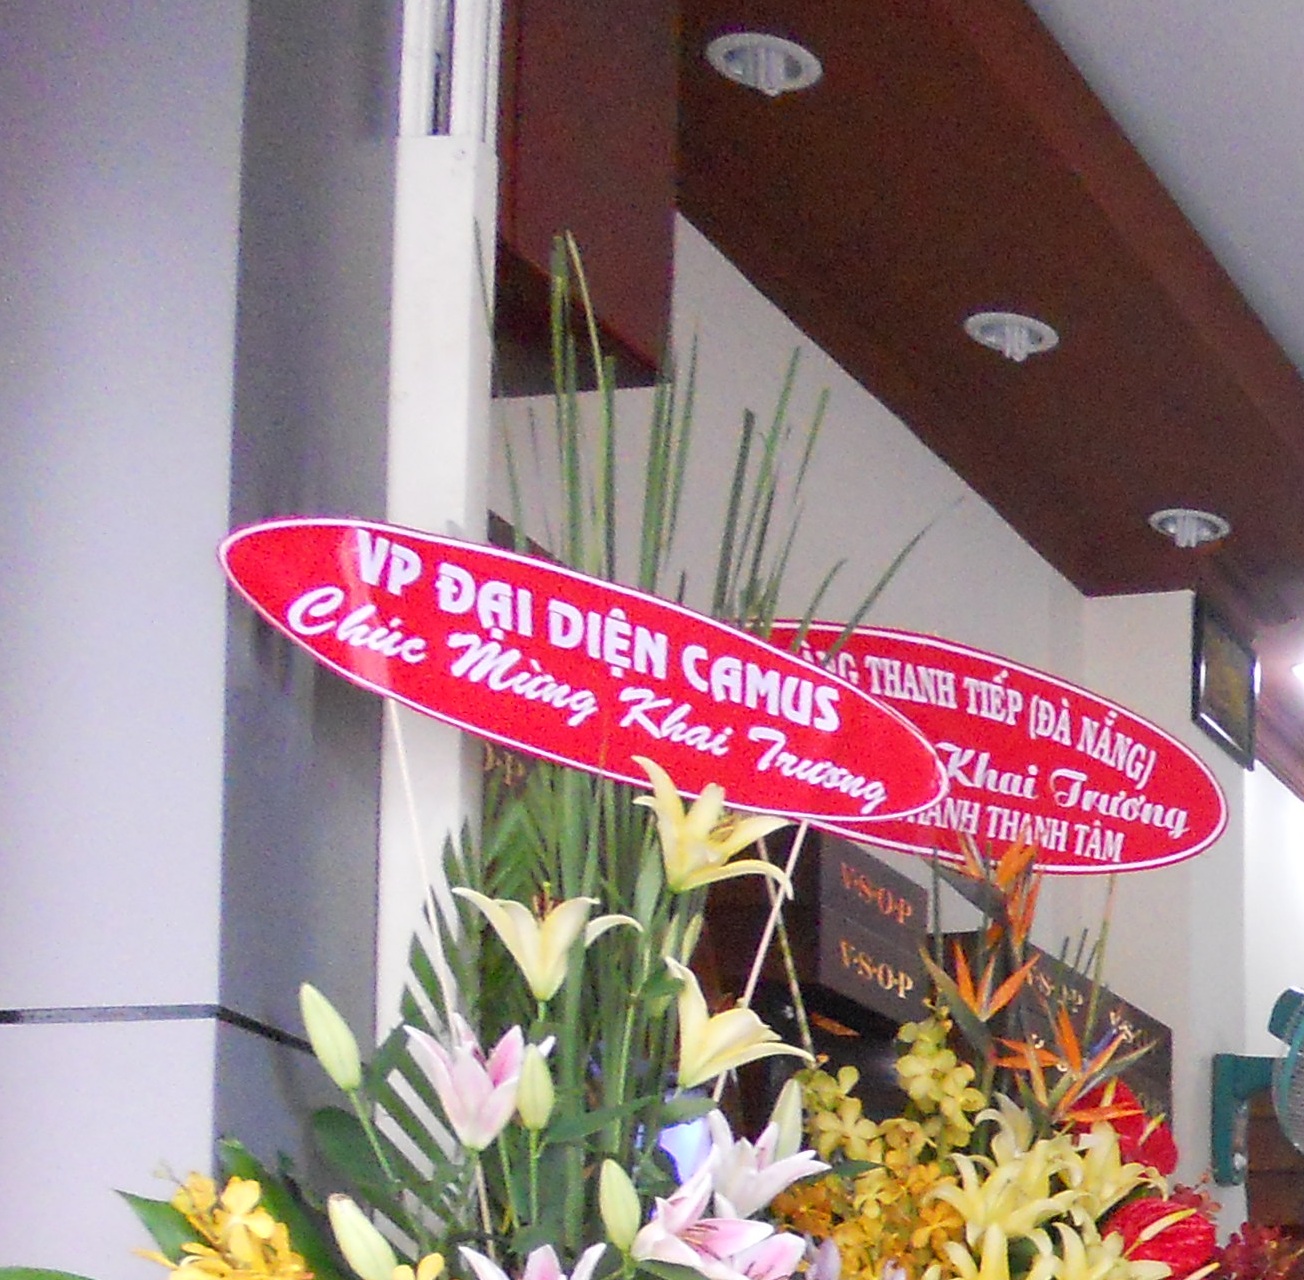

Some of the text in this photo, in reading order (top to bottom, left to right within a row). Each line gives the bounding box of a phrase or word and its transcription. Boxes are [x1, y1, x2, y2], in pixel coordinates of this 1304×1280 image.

[356, 529, 840, 732] VP ĐẠI DIỆN CAMUS
[287, 586, 887, 814] Chúc Mừng Khai Trương
[864, 655, 958, 709] THANH
[963, 670, 1024, 726] TIẾP
[1030, 695, 1072, 747] (ĐÀ
[934, 742, 1190, 840] Khai Trương
[986, 804, 1069, 852] THANH
[1074, 820, 1125, 863] TÂM
